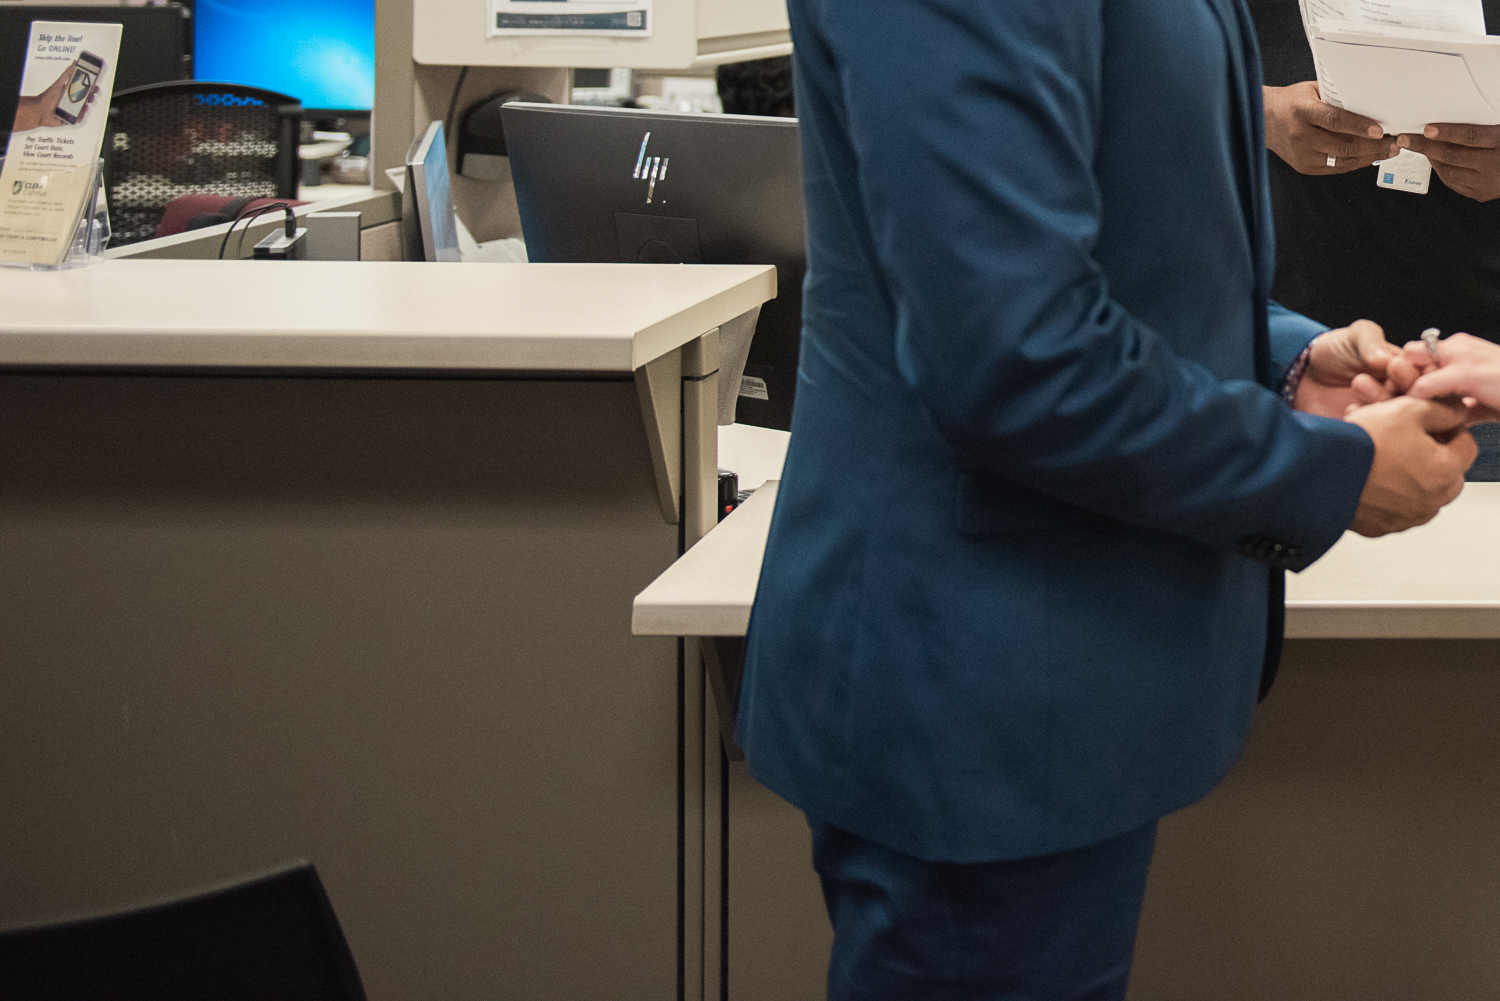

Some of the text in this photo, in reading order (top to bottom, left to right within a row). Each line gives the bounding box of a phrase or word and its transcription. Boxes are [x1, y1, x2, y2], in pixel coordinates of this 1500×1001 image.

[38, 33, 84, 43] Skip the line!
[37, 44, 77, 53] Go ONLINE!
[633, 131, 670, 204] hp
